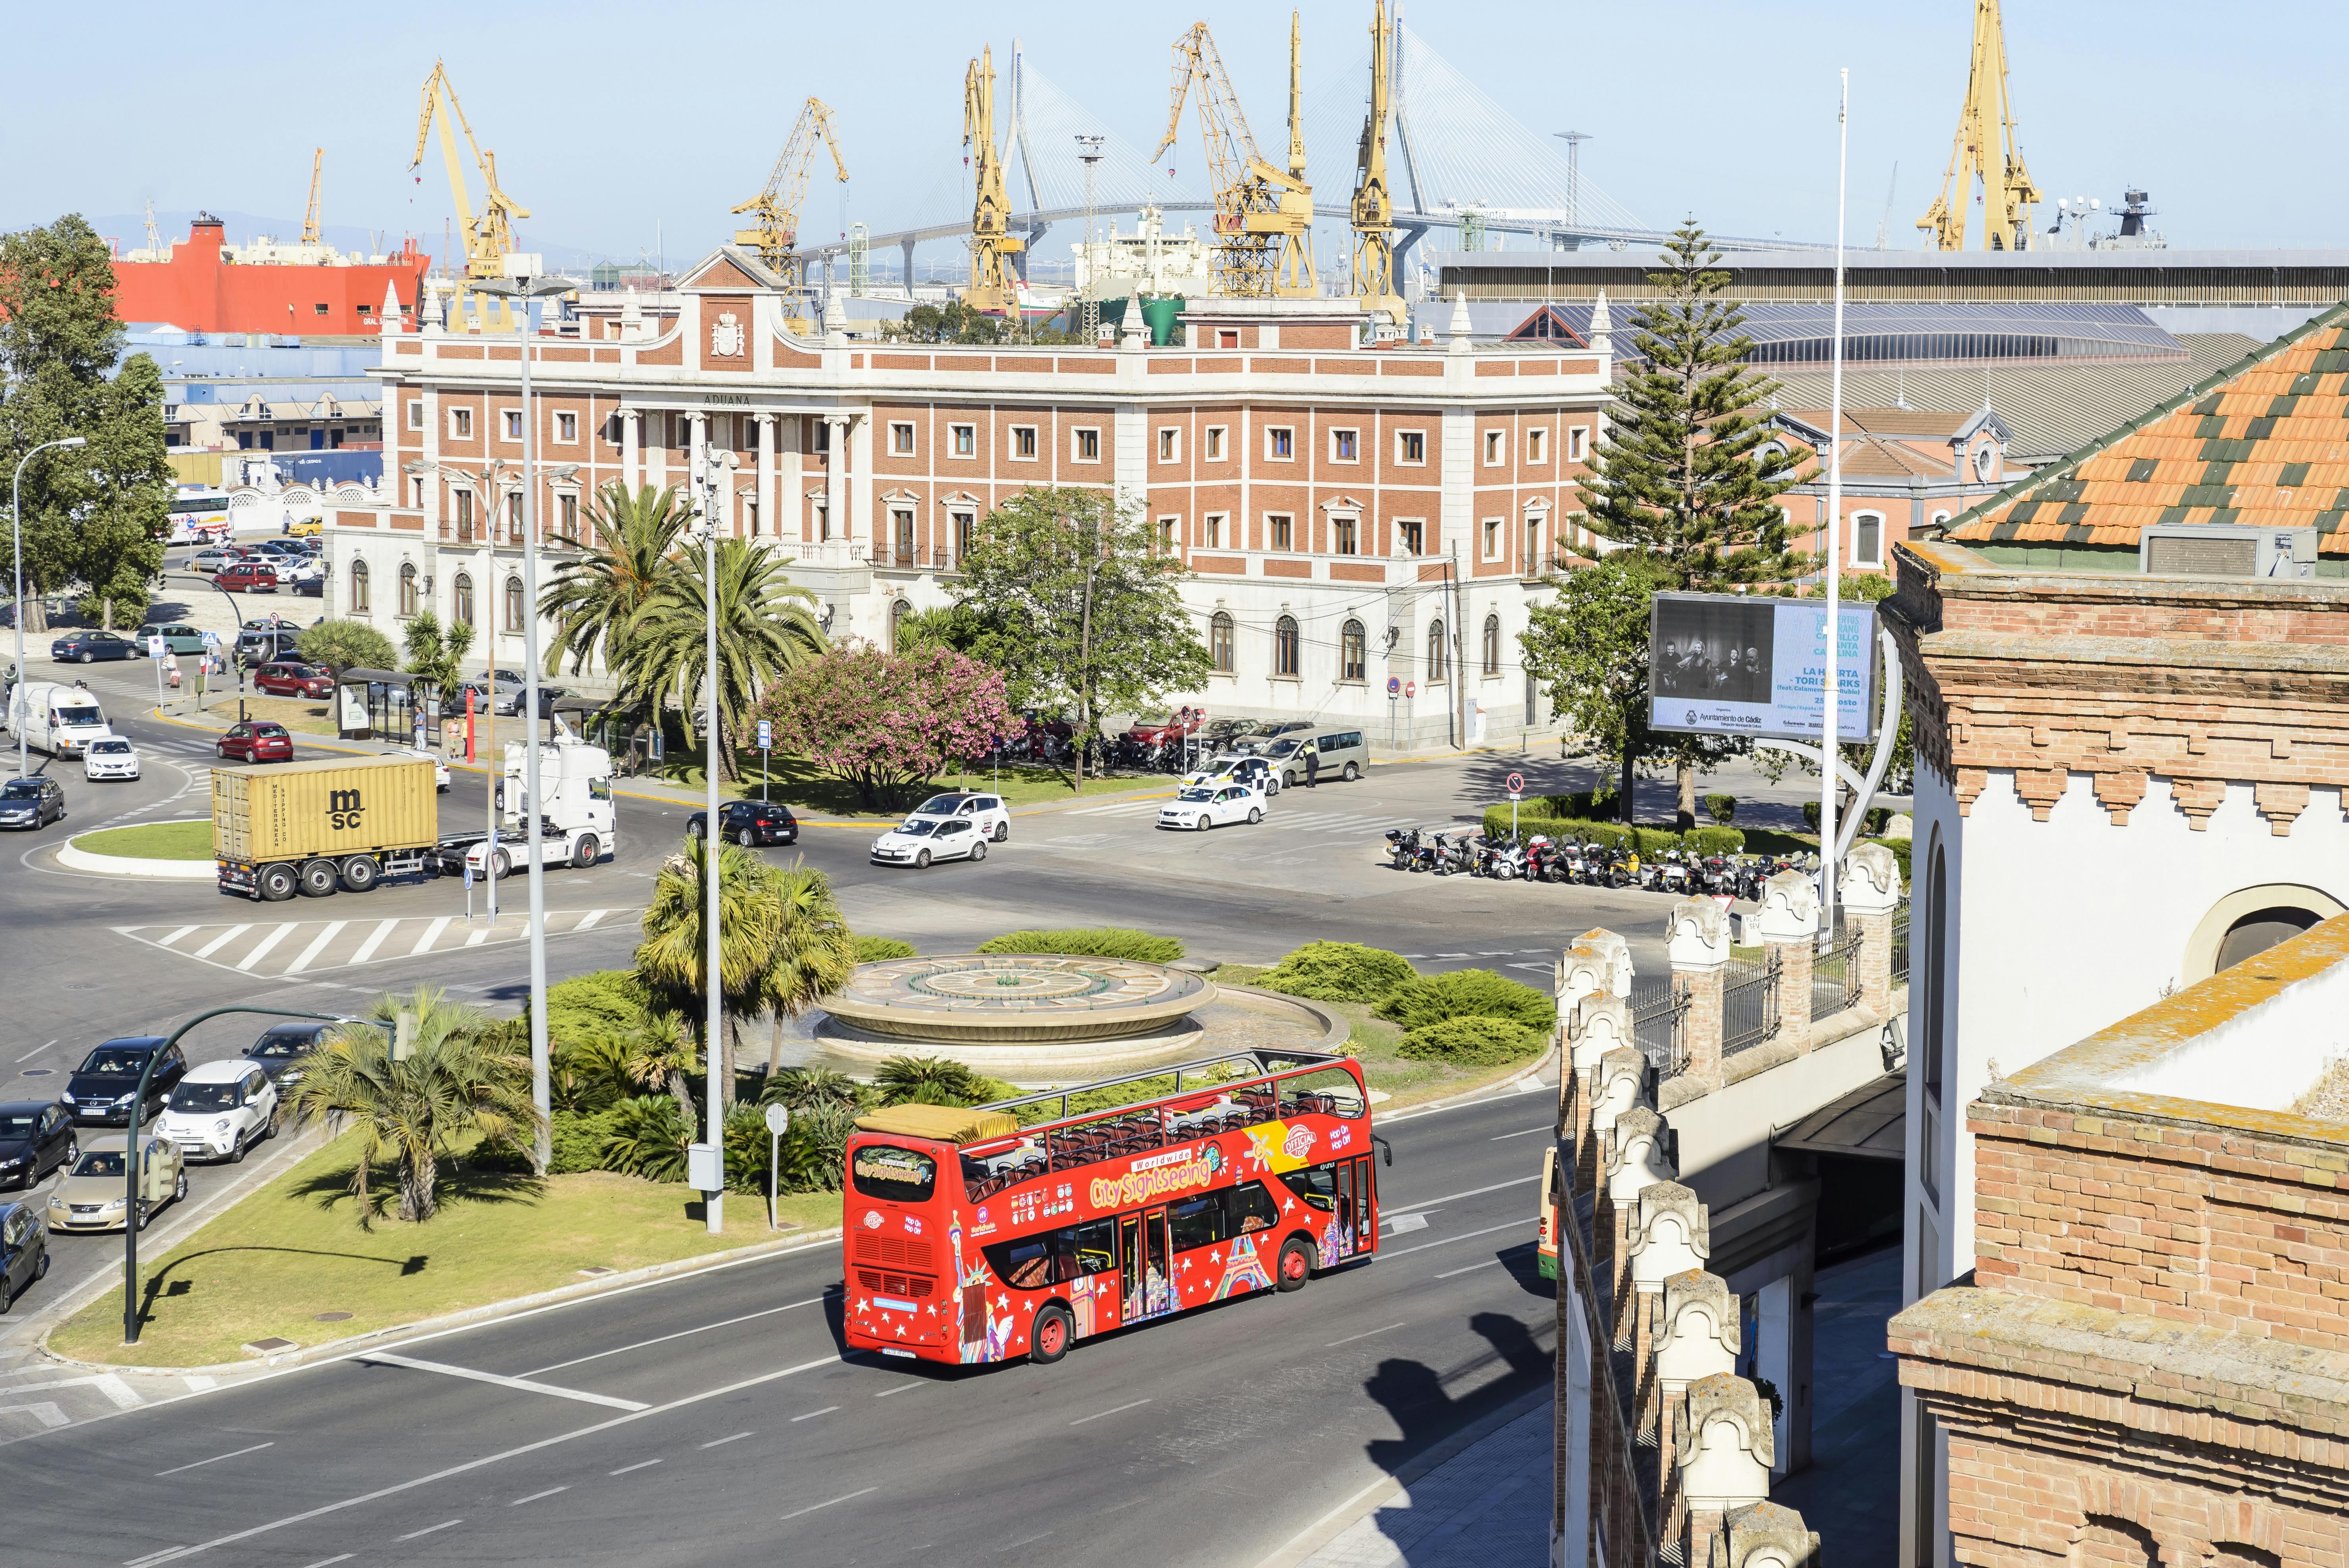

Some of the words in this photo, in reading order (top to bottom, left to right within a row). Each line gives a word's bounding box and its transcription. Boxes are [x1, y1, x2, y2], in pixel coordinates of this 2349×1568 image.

[704, 395, 750, 406] ADUANA
[1816, 633, 1859, 641] CAILLO
[1813, 648, 1858, 658] CALINA
[1795, 677, 1818, 685] TORI
[1700, 713, 1736, 722] Ayuntamiento
[282, 832, 286, 841] CO
[1330, 1130, 1341, 1140] Hop
[1341, 1124, 1349, 1134] On
[1286, 1134, 1315, 1152] OFFICIAL
[1332, 1140, 1342, 1151] Hop
[1342, 1134, 1351, 1146] Off
[1295, 1146, 1308, 1156] TOUR
[1137, 1151, 1190, 1170] Worldwide
[865, 1217, 884, 1225] OFFICIAL
[905, 1216, 914, 1225] Hop
[904, 1223, 913, 1232] Hop
